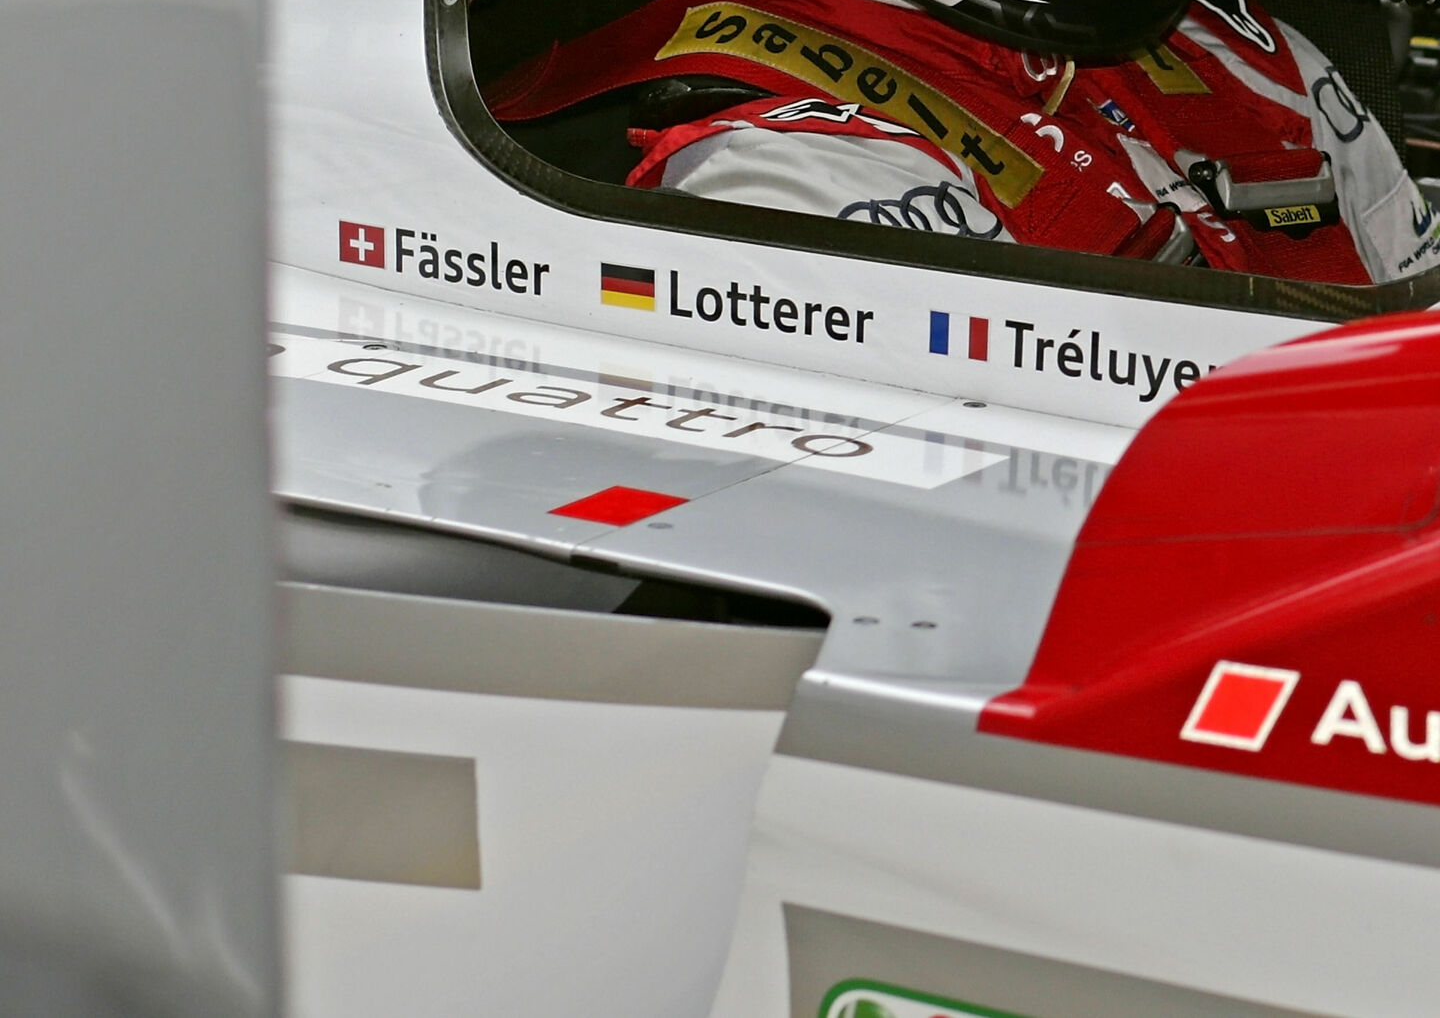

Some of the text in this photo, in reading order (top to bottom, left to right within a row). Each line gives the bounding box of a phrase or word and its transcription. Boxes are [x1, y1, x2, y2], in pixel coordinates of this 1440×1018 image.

[695, 10, 1005, 176] Sabelt
[1271, 208, 1315, 224] Sabelt
[395, 227, 550, 296] Fässler
[670, 269, 874, 343] Lotterer
[1005, 320, 1219, 403] Tréluye
[326, 355, 875, 458] quattro
